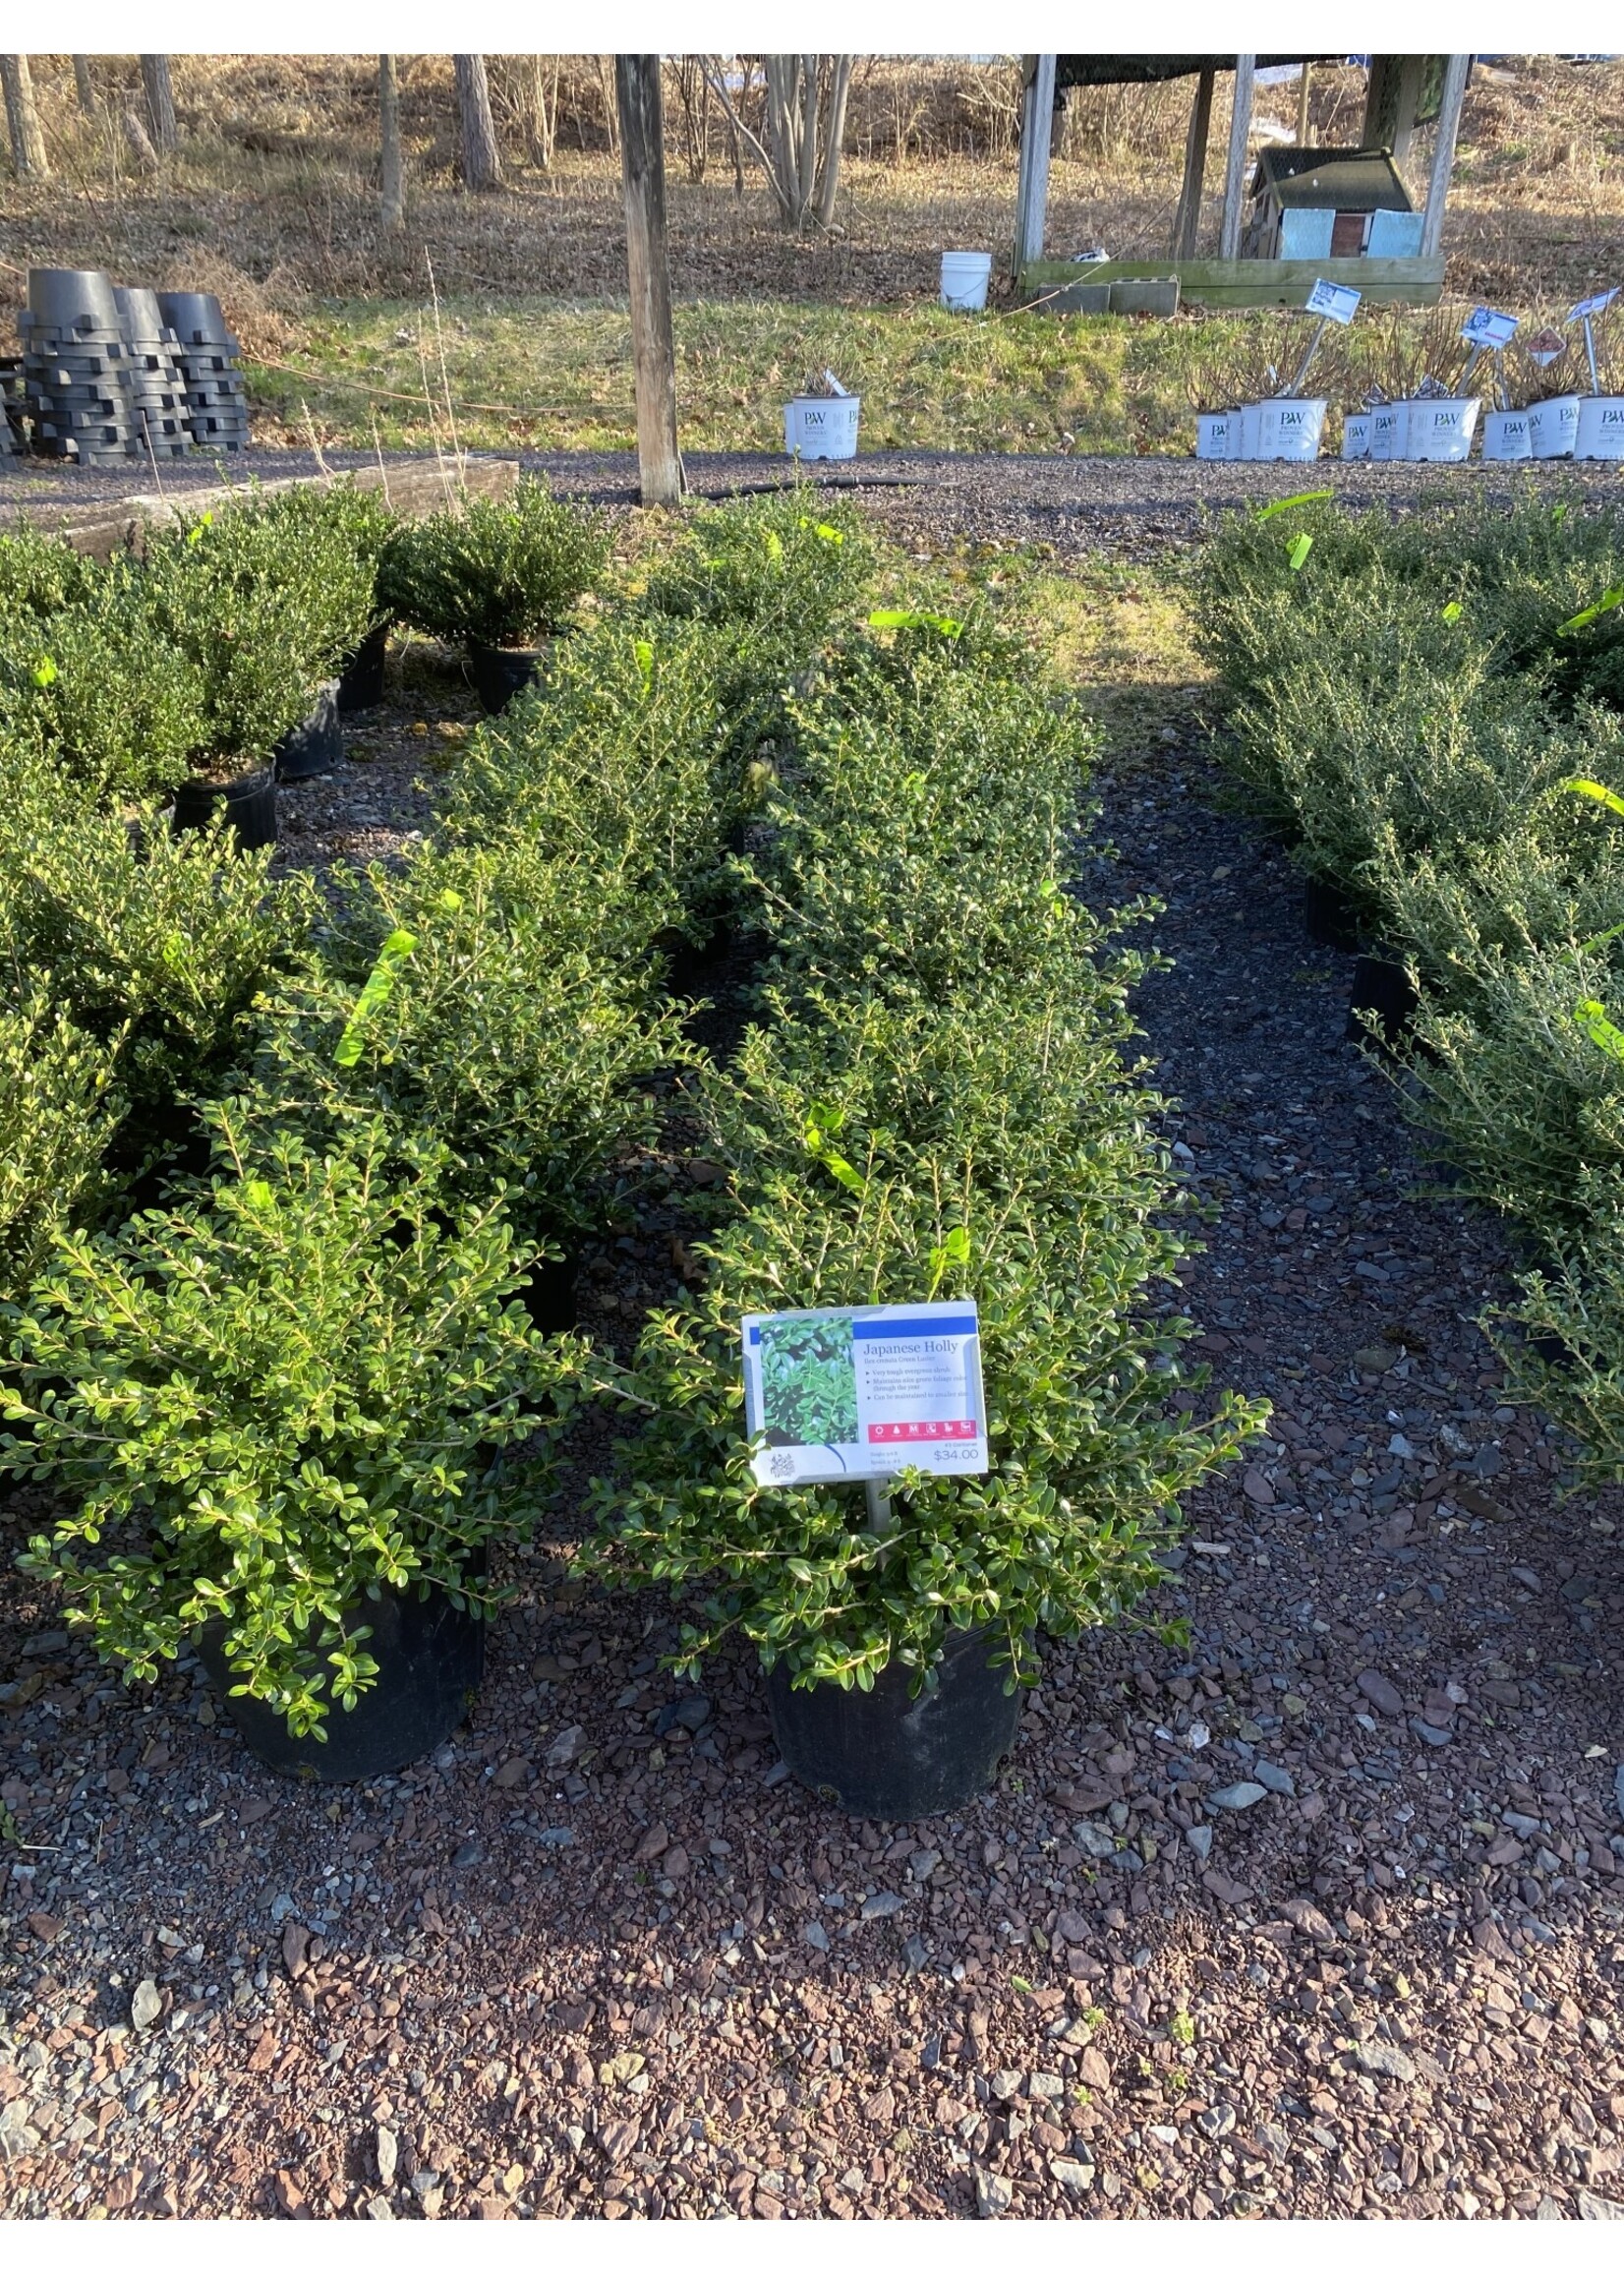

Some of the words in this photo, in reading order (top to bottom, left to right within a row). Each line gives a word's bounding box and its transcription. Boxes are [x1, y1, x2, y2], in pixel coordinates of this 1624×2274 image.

[863, 1343, 921, 1357] Japanese
[925, 1340, 958, 1354] Holly
[934, 1449, 978, 1462] $34.00
